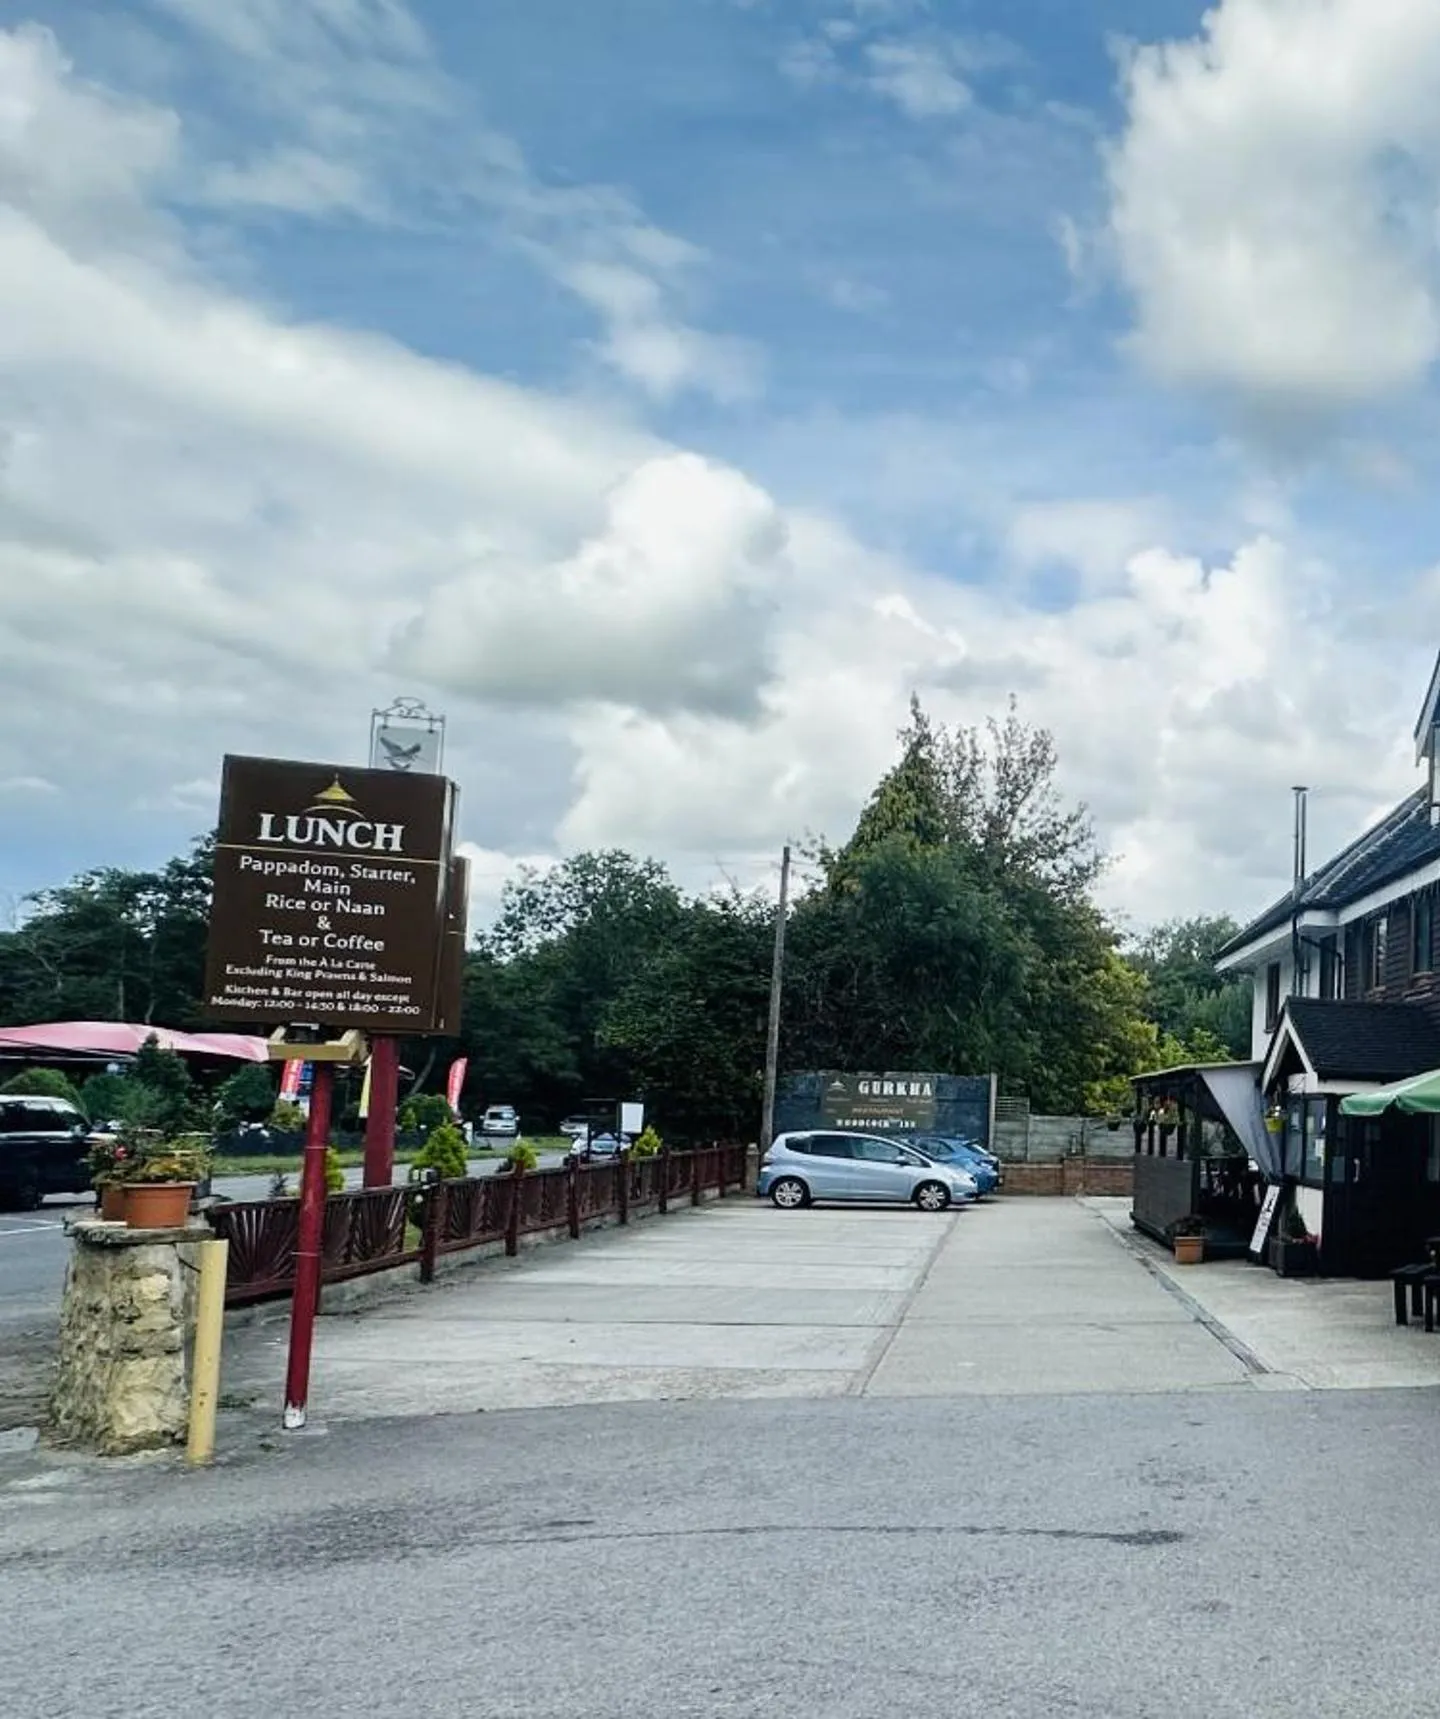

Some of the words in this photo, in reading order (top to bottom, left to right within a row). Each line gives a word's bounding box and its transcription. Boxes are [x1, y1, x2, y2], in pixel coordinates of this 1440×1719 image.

[257, 813, 405, 852] LUNCH
[239, 855, 345, 879] Pappadom,
[350, 863, 416, 884] Starter,
[303, 879, 351, 896] Main
[265, 894, 306, 911] Rice
[310, 901, 332, 912] or
[336, 899, 385, 916] Naan
[316, 915, 332, 931] &
[259, 929, 293, 946] Tea
[299, 935, 320, 948] or
[323, 934, 385, 951] Coffee
[266, 954, 296, 965] From
[299, 957, 317, 967] the
[331, 958, 343, 968] La
[346, 960, 376, 970] Carte
[226, 964, 282, 978] Excluding
[285, 967, 312, 980] King
[314, 969, 356, 981] Prawns
[358, 971, 367, 981] &
[370, 972, 412, 984] Salmon
[211, 996, 261, 1009] Monday:
[337, 1002, 345, 1011] &
[225, 984, 269, 996] Kitchen
[271, 987, 280, 996] &
[283, 987, 303, 997] Bar
[305, 991, 333, 1000] open
[336, 990, 350, 1000] all
[352, 991, 372, 1002] day
[374, 993, 410, 1004] except
[858, 1080, 933, 1096] GURKHA
